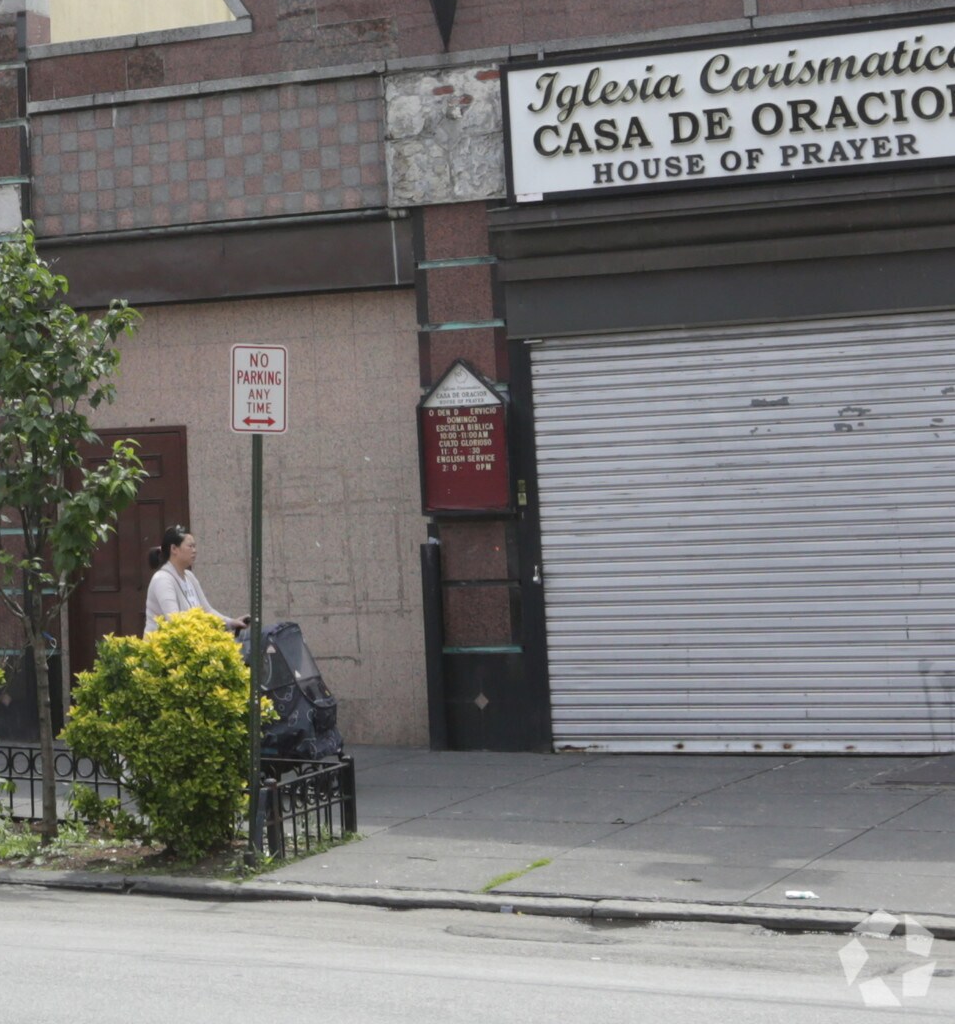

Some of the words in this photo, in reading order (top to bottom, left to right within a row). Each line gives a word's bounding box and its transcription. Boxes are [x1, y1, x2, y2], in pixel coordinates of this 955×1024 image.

[527, 65, 683, 123] Iglesia
[533, 115, 653, 158] CASA
[668, 107, 733, 145] DE
[592, 153, 706, 184] HOUSE
[720, 148, 764, 173] OF
[780, 133, 920, 168] PRAYER
[250, 353, 269, 367] NO
[237, 370, 281, 385] PARKING
[248, 388, 270, 400] ANY
[247, 402, 272, 414] TIME
[436, 424, 464, 432] ESCUELA
[467, 423, 494, 431] BIBLICA
[467, 454, 495, 462] SERVICE
